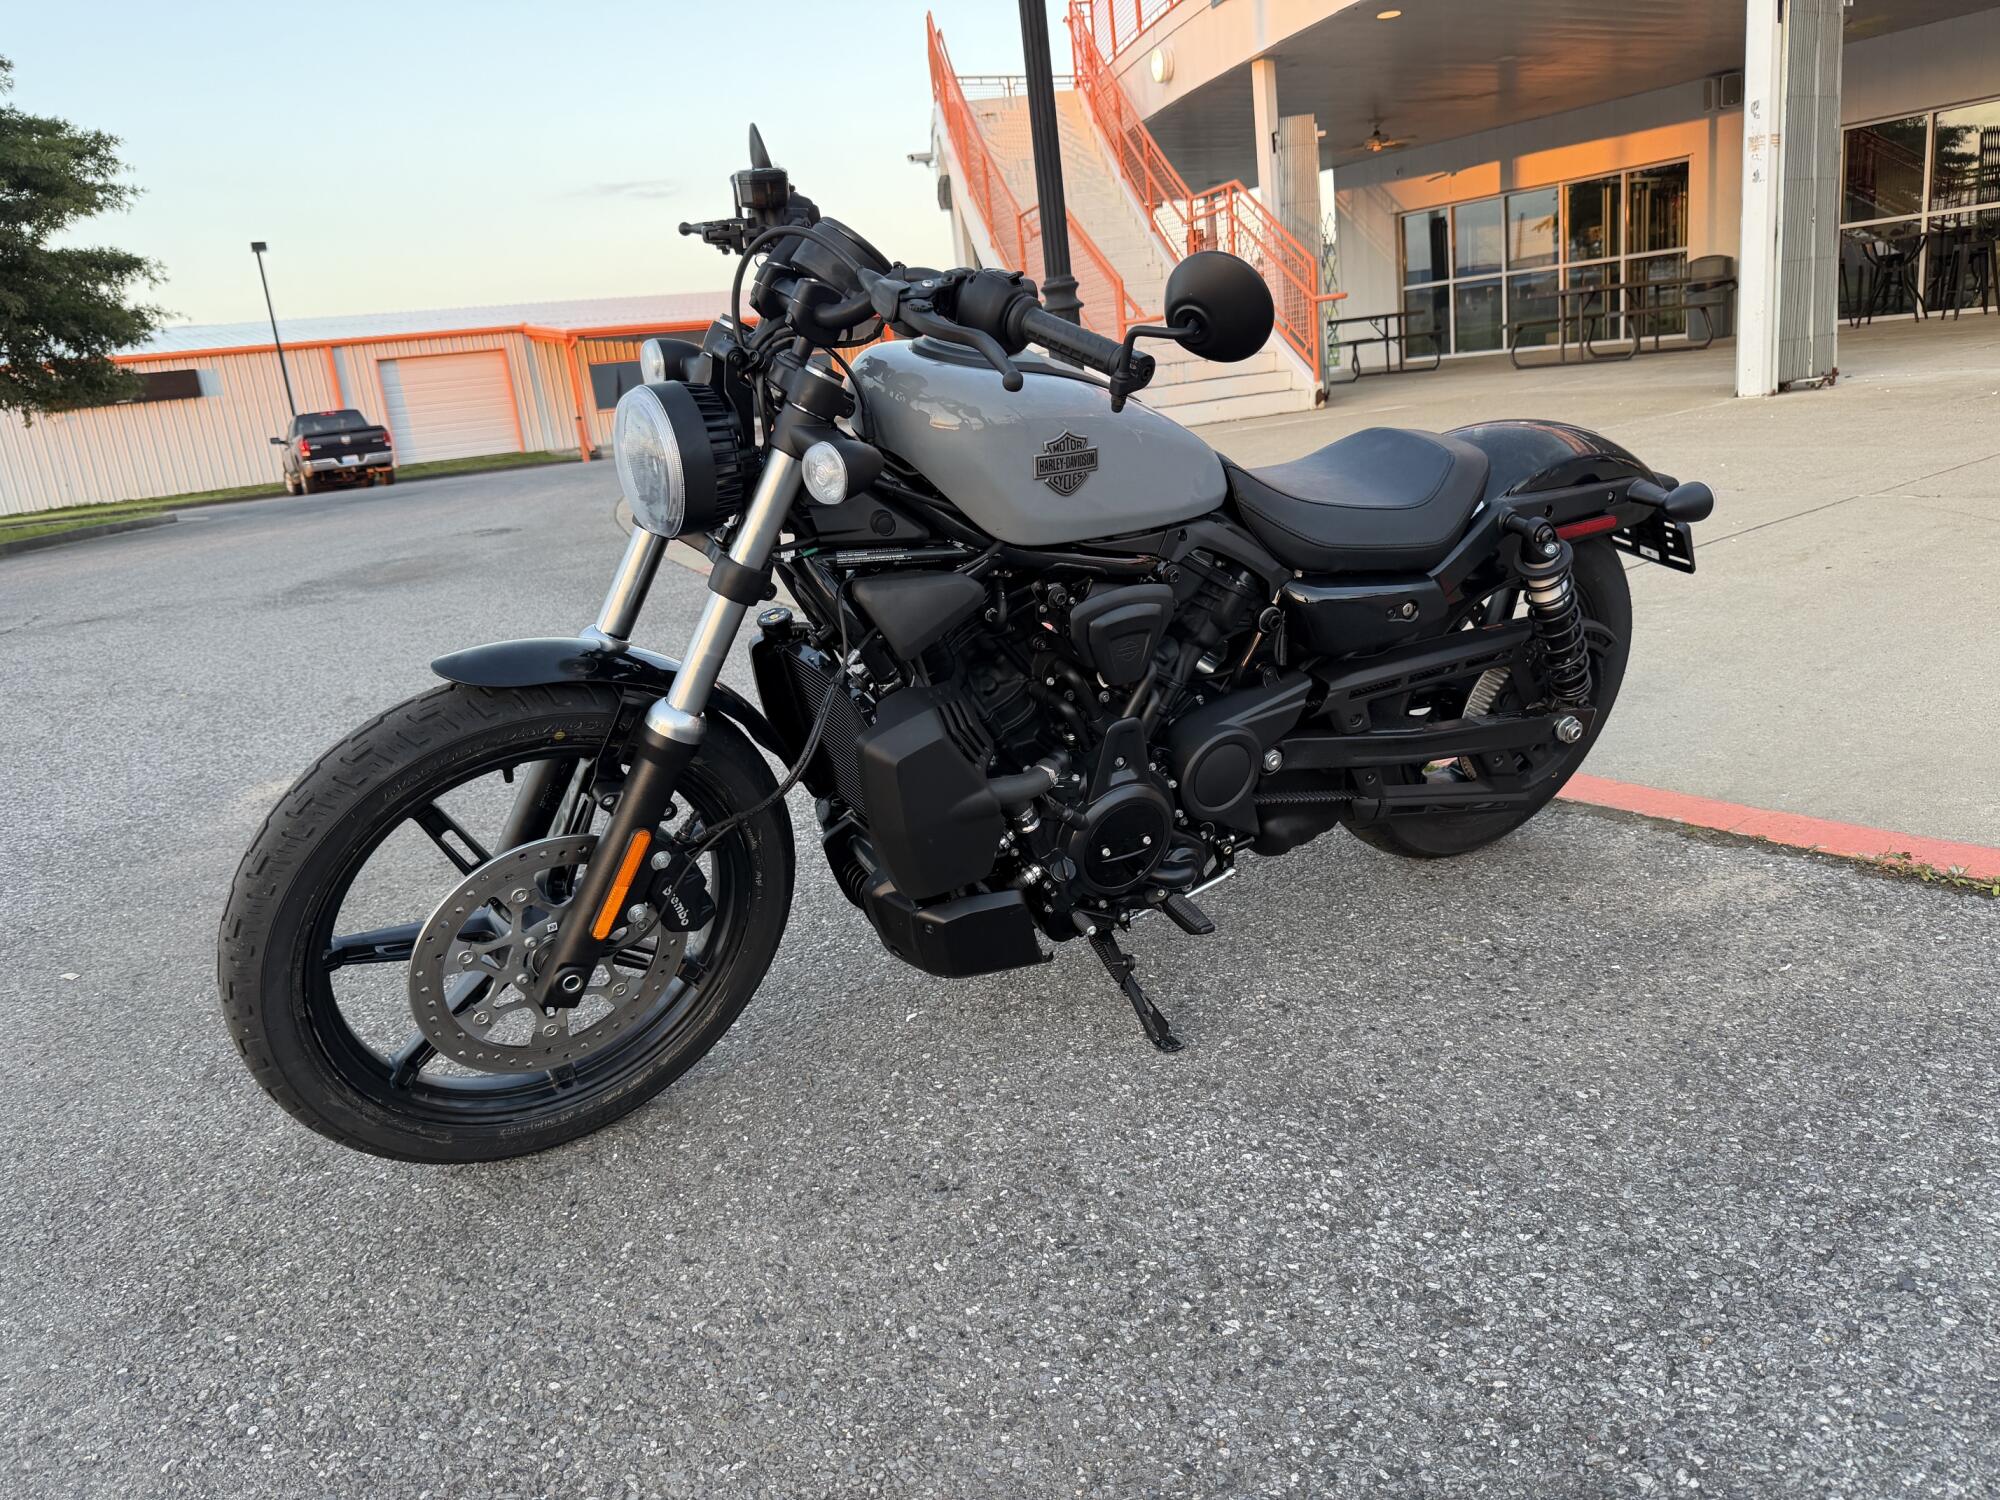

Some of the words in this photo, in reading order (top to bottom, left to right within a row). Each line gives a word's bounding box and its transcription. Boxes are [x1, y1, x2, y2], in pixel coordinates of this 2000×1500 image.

[1053, 436, 1083, 453] MOTOR
[1039, 451, 1095, 473] HARLEY-DAVIDSON
[1053, 471, 1083, 490] CYCLES
